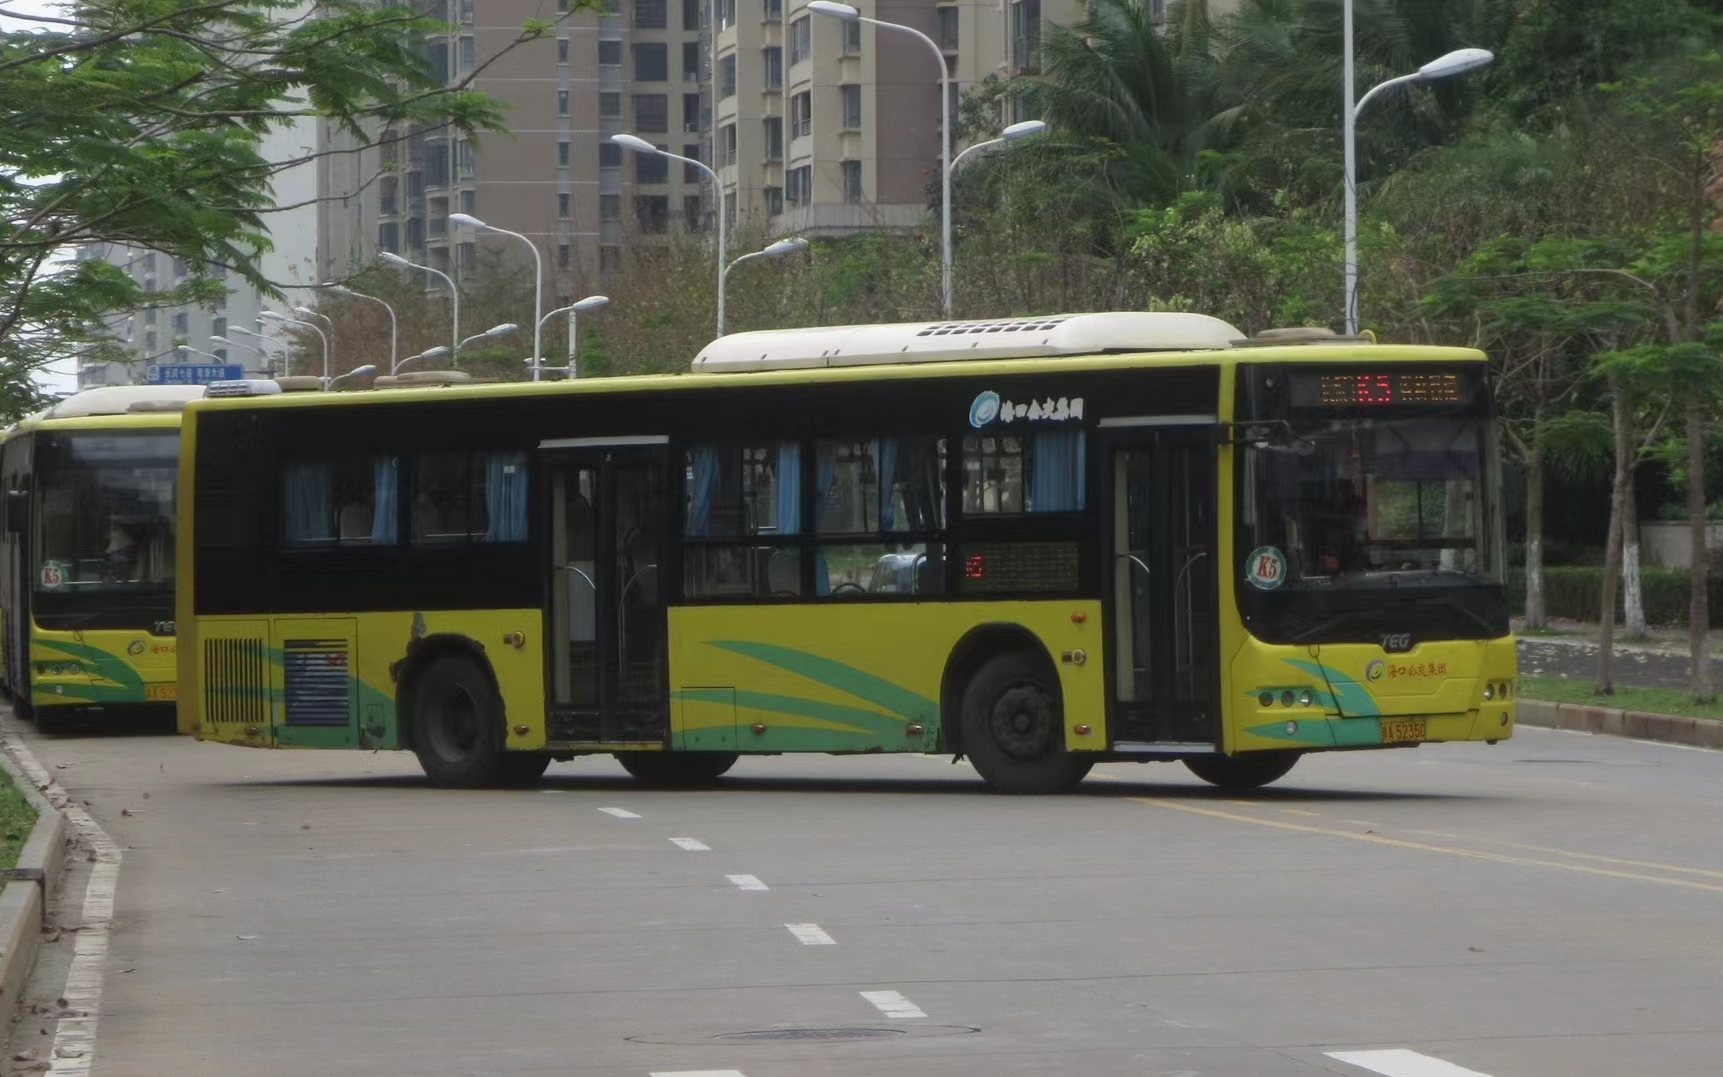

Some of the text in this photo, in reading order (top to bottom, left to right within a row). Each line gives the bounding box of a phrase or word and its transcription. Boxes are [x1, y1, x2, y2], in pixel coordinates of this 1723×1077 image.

[1258, 556, 1278, 579] K5
[44, 568, 59, 584] K5
[154, 621, 176, 632] TE
